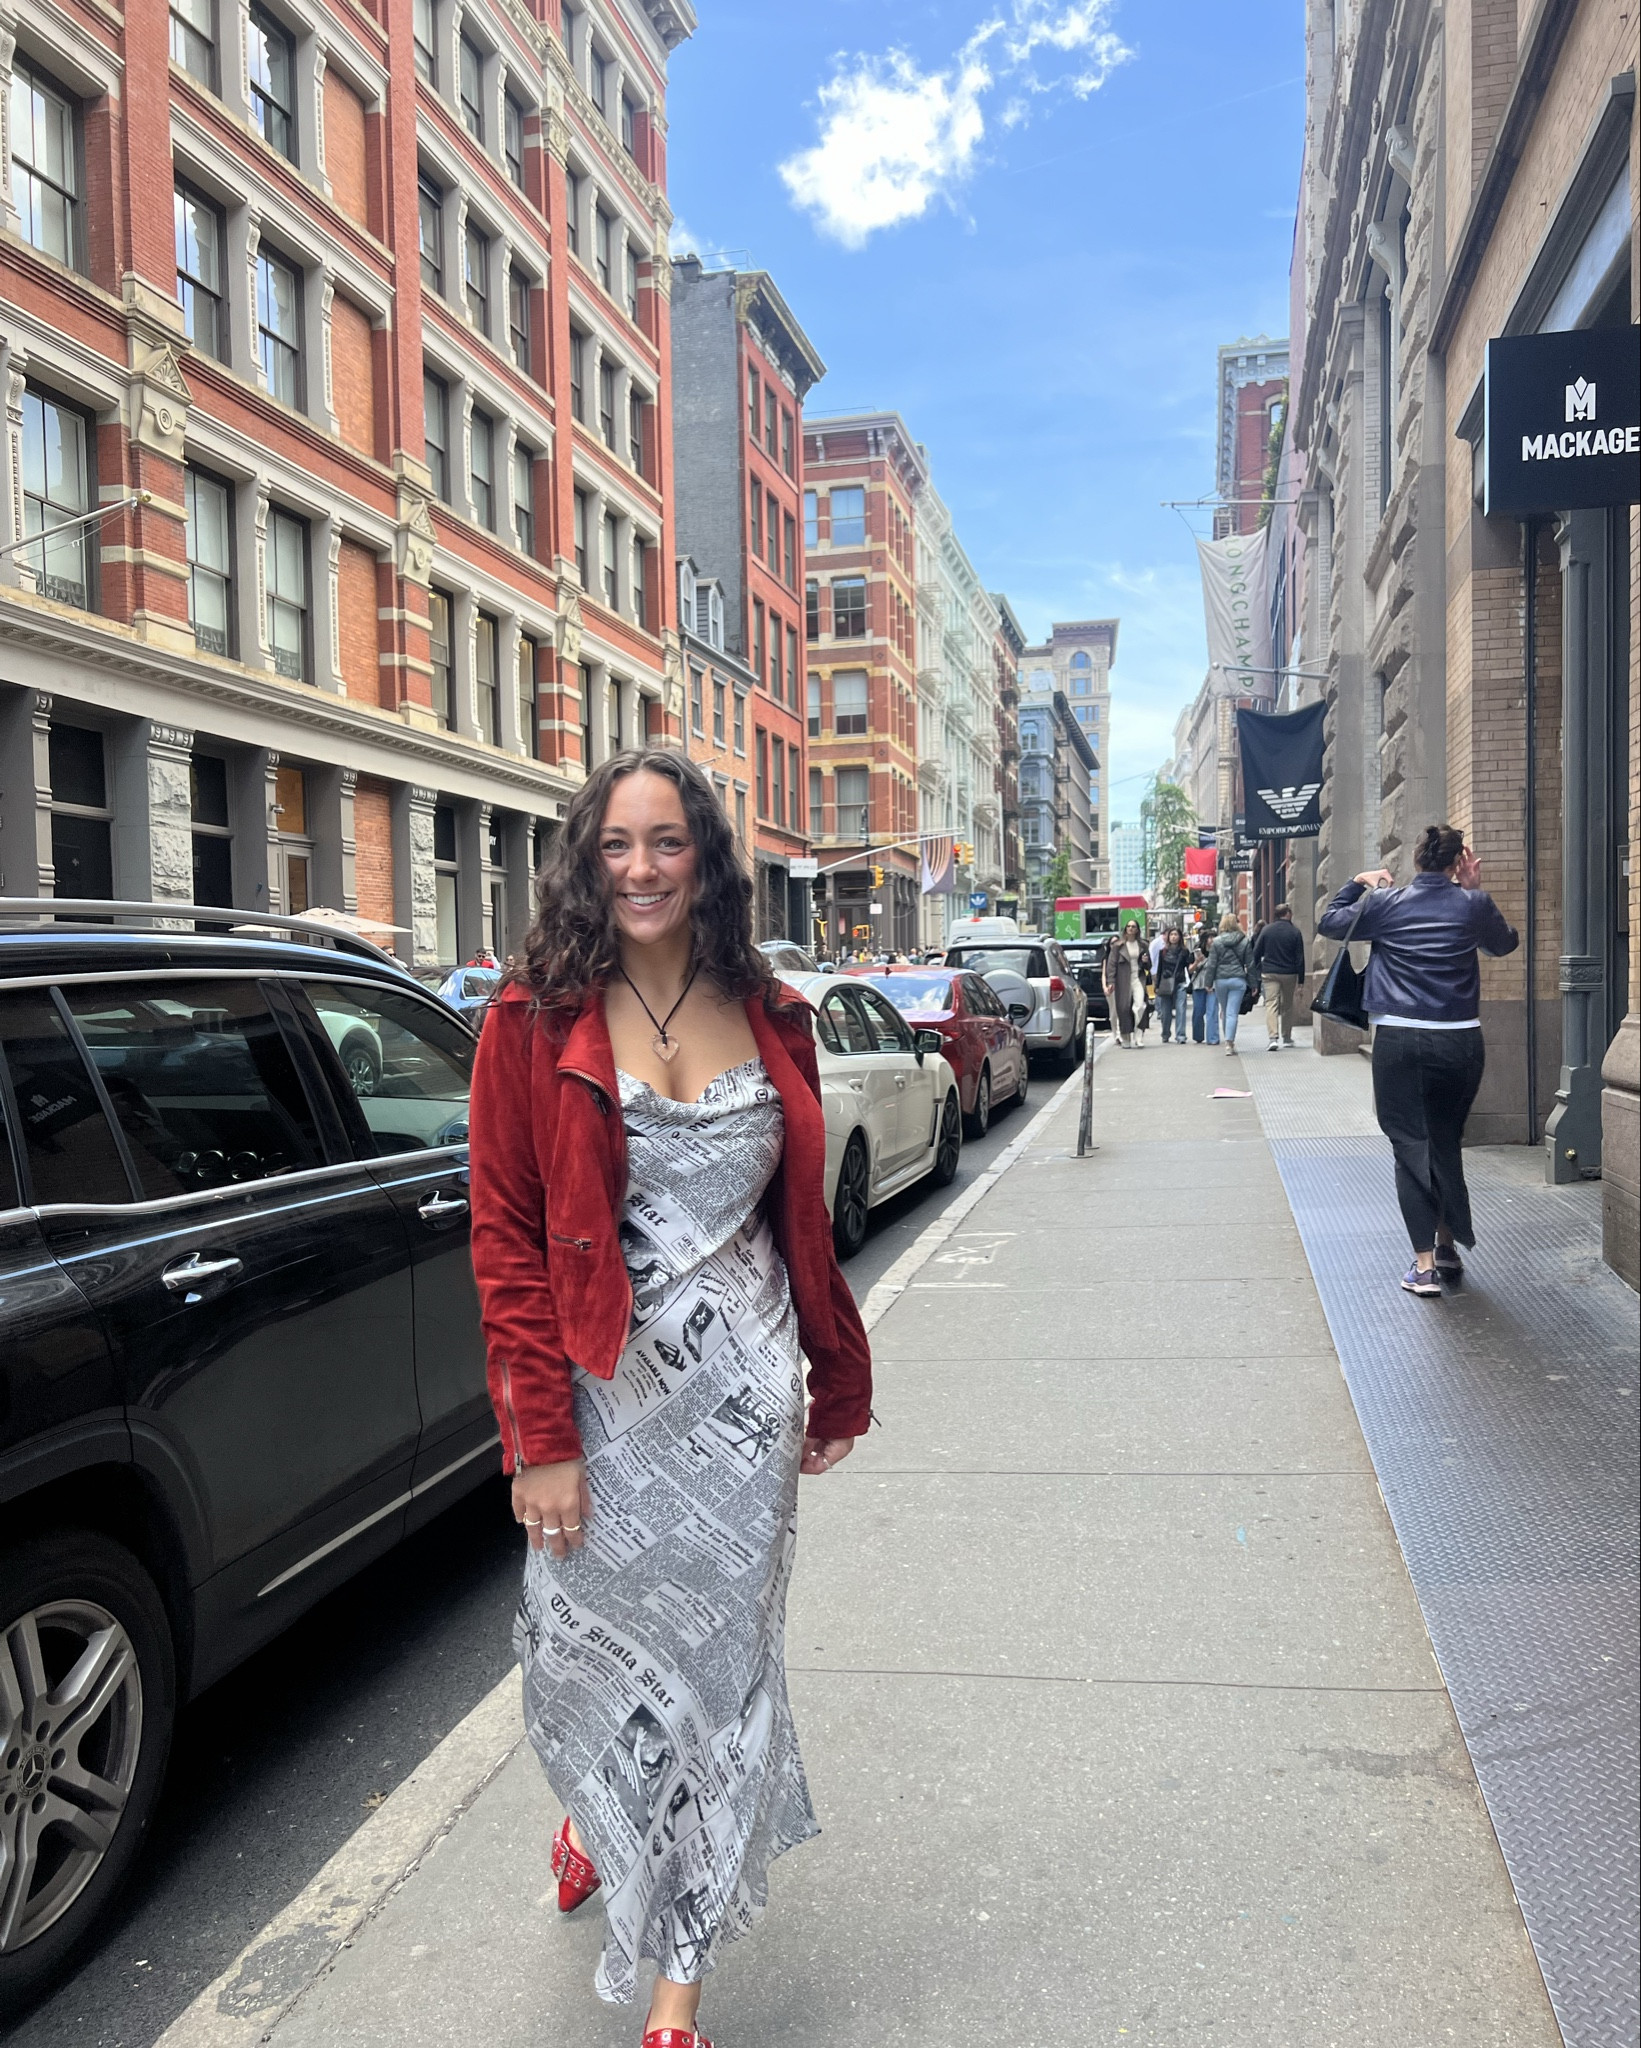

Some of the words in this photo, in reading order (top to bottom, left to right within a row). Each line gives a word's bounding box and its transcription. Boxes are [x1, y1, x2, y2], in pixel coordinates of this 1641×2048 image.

[1522, 427, 1640, 461] MACKAGE
[1259, 826, 1289, 835] EMPORIO
[1300, 823, 1322, 832] ARMAN
[1187, 874, 1213, 886] DIESEL
[627, 1193, 667, 1226] Star
[635, 1349, 661, 1378] AVAILABLE
[657, 1377, 671, 1395] NOW
[551, 1594, 580, 1630] The
[580, 1626, 637, 1671] Strata
[635, 1668, 675, 1708] Star
